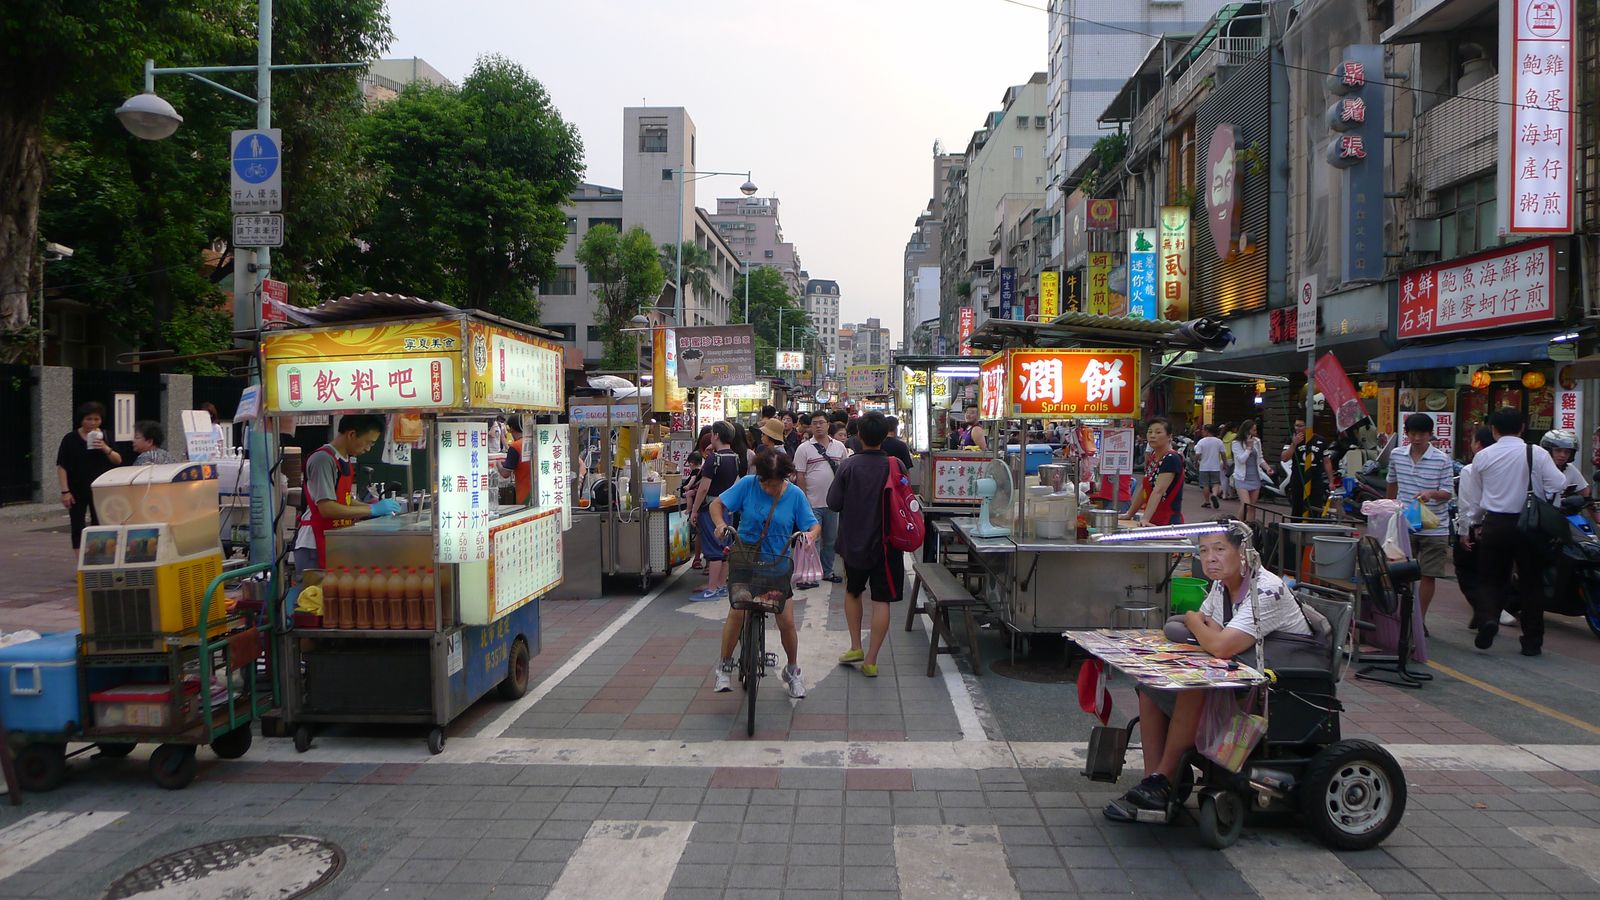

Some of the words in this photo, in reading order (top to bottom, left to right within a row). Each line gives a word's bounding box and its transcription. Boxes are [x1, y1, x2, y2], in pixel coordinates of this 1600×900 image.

[1520, 53, 1542, 215] 鮑魚海產粥
[1542, 53, 1565, 215] 雞蛋蚵仔煎
[234, 189, 279, 199] 行人優先
[1440, 252, 1545, 295] 鮑魚海鮮粥
[1439, 281, 1546, 321] 雞蛋蚵仔煎
[312, 366, 417, 404] 飲料吧
[474, 380, 487, 399] 001
[1018, 357, 1127, 408] 潤餅
[1041, 401, 1077, 413] Spring
[1084, 402, 1109, 412] rolls
[1561, 392, 1577, 434] 雞蛋
[441, 429, 453, 529] 楊桃汁
[456, 429, 469, 529] 甘蔗汁
